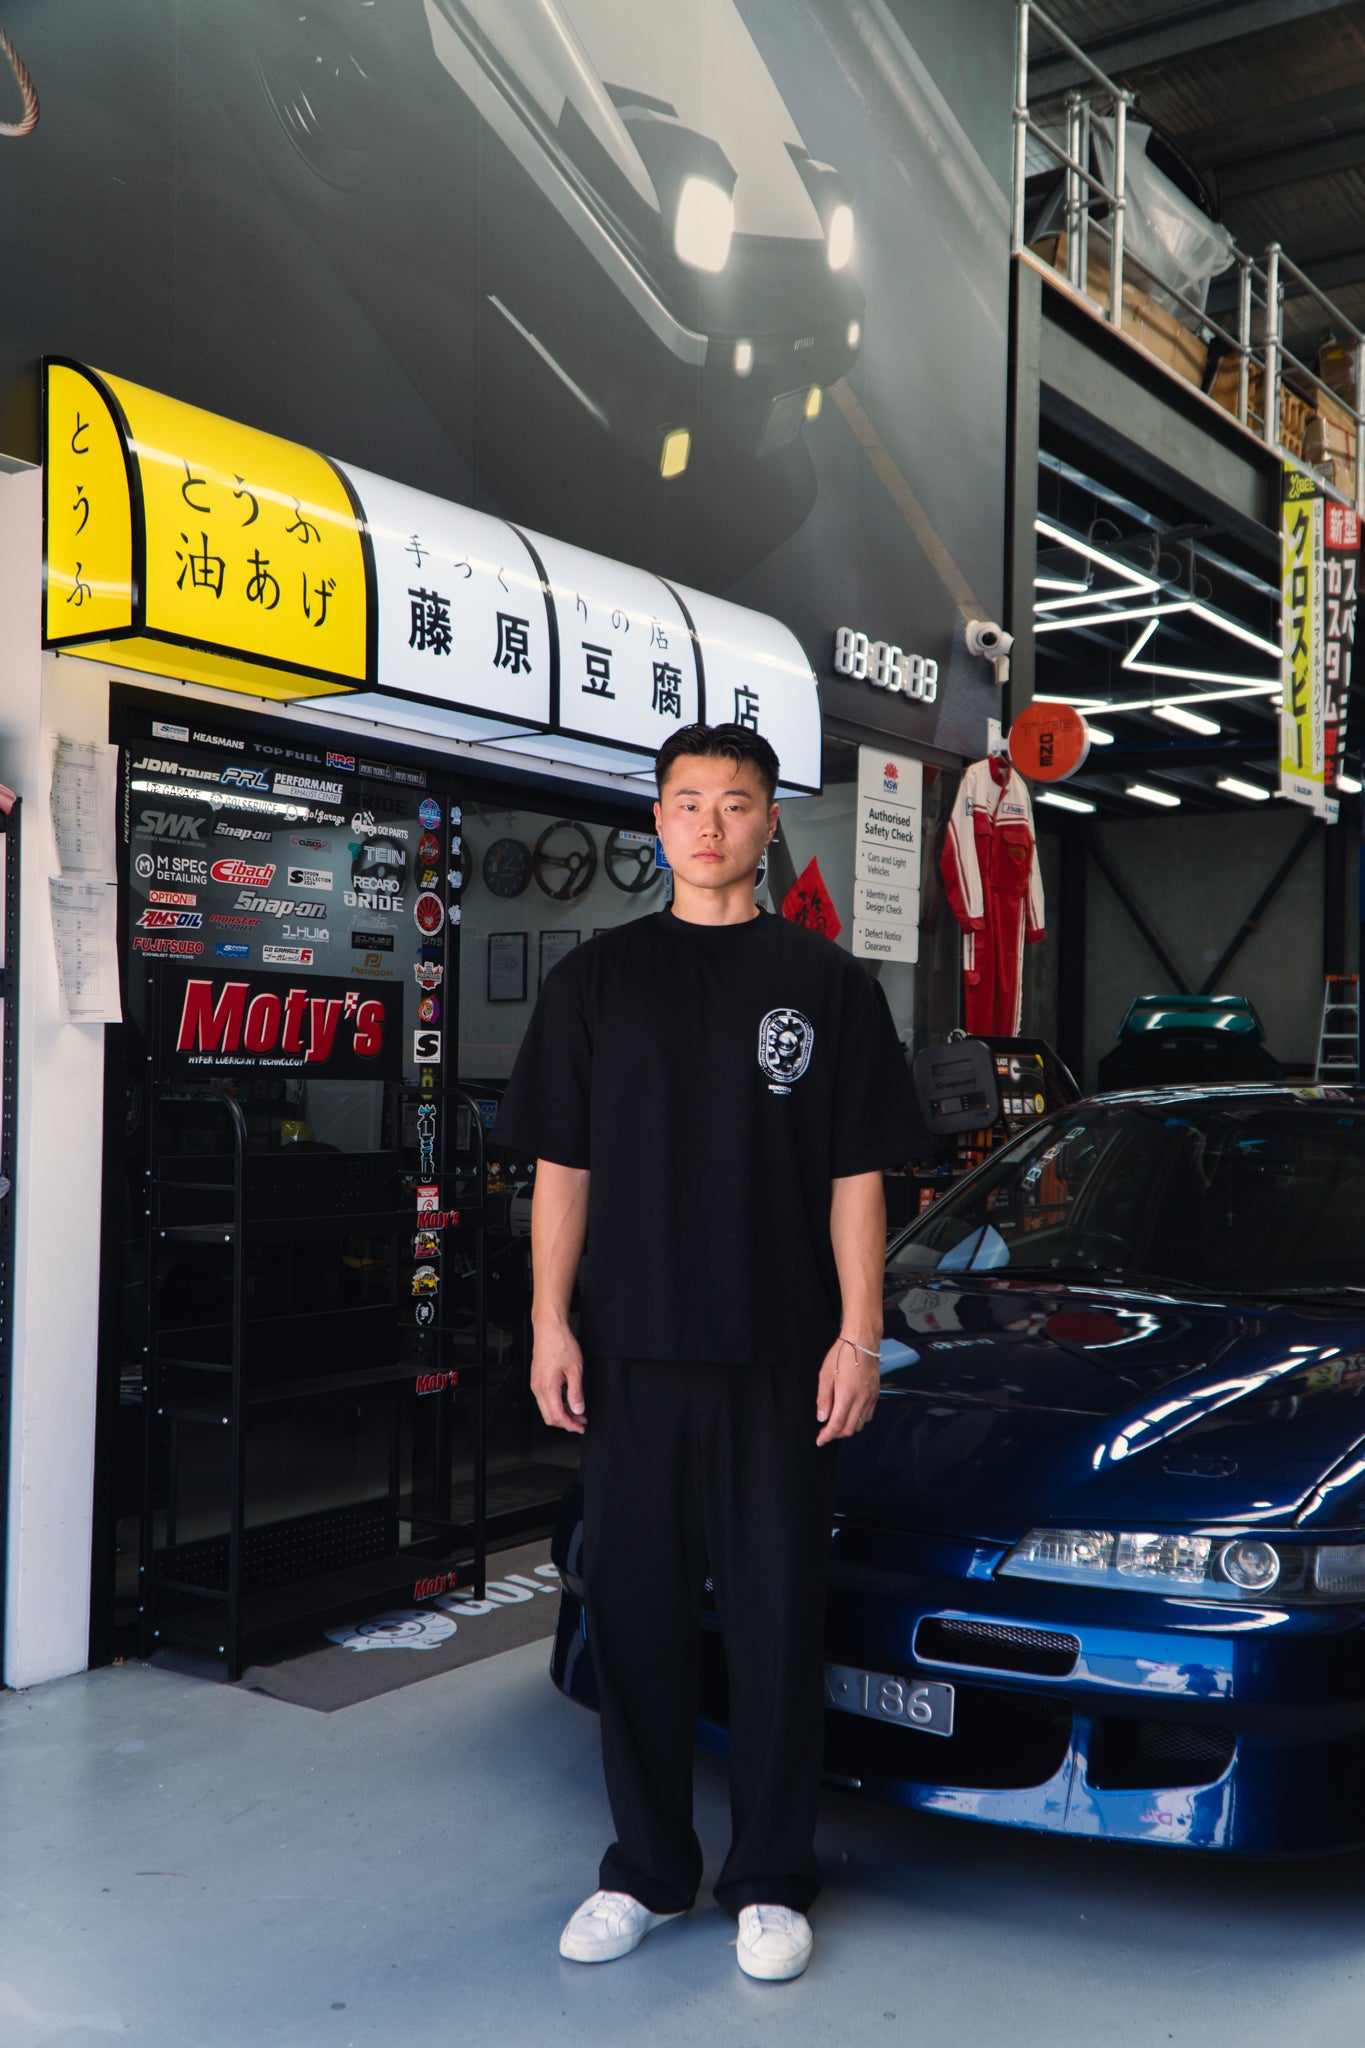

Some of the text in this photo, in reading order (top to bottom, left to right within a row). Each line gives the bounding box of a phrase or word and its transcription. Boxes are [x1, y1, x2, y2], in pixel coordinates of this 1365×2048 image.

[67, 411, 92, 607] とうふ
[181, 458, 322, 544] とうふ
[1330, 507, 1358, 545] 新型
[175, 531, 337, 627] 油あげ
[1291, 506, 1310, 769] クロスビー
[1324, 556, 1342, 721] カスタム
[407, 586, 760, 734] 藤原豆腐店
[192, 731, 246, 750] HEASMANS
[1039, 732, 1054, 767] ONE
[253, 743, 322, 764] TOP FUEL
[326, 751, 355, 772] HRC
[132, 757, 221, 782] JDM TOURS
[221, 766, 270, 791] PRL
[274, 772, 344, 794] PERFORMANCE
[883, 778, 899, 792] NSW
[290, 787, 341, 803] EXHAUST CENTRE
[135, 809, 207, 840] SWK
[868, 807, 912, 827] Authorised
[213, 822, 272, 841] Snap-on
[864, 822, 914, 843] Safety Check
[157, 855, 208, 875] M SPEC
[363, 845, 406, 866] TEIN
[867, 852, 907, 869] Cars and Light
[157, 870, 208, 885] DETAILING
[210, 860, 275, 886] Eibach
[867, 864, 890, 877] Vehicles
[353, 875, 400, 893] RECARO
[866, 887, 900, 902] Identity and
[150, 891, 188, 905] OPTION
[233, 890, 327, 919] Snap-on
[343, 890, 404, 913] BRIDE
[866, 900, 903, 915] Design Check
[139, 910, 202, 928] AMSOIL
[209, 914, 262, 926] monster
[133, 936, 205, 955] FUJITSUBO
[864, 928, 903, 942] Defect Notice
[142, 951, 195, 960] EXHAUST SYSTEMS
[864, 940, 892, 953] Clearance
[351, 966, 395, 977] Paragon
[176, 979, 386, 1064] Moty's
[416, 1209, 461, 1229] Moty's
[416, 1370, 459, 1394] Moty's
[413, 1571, 458, 1600] Moty's
[434, 1574, 558, 1616] GO!
